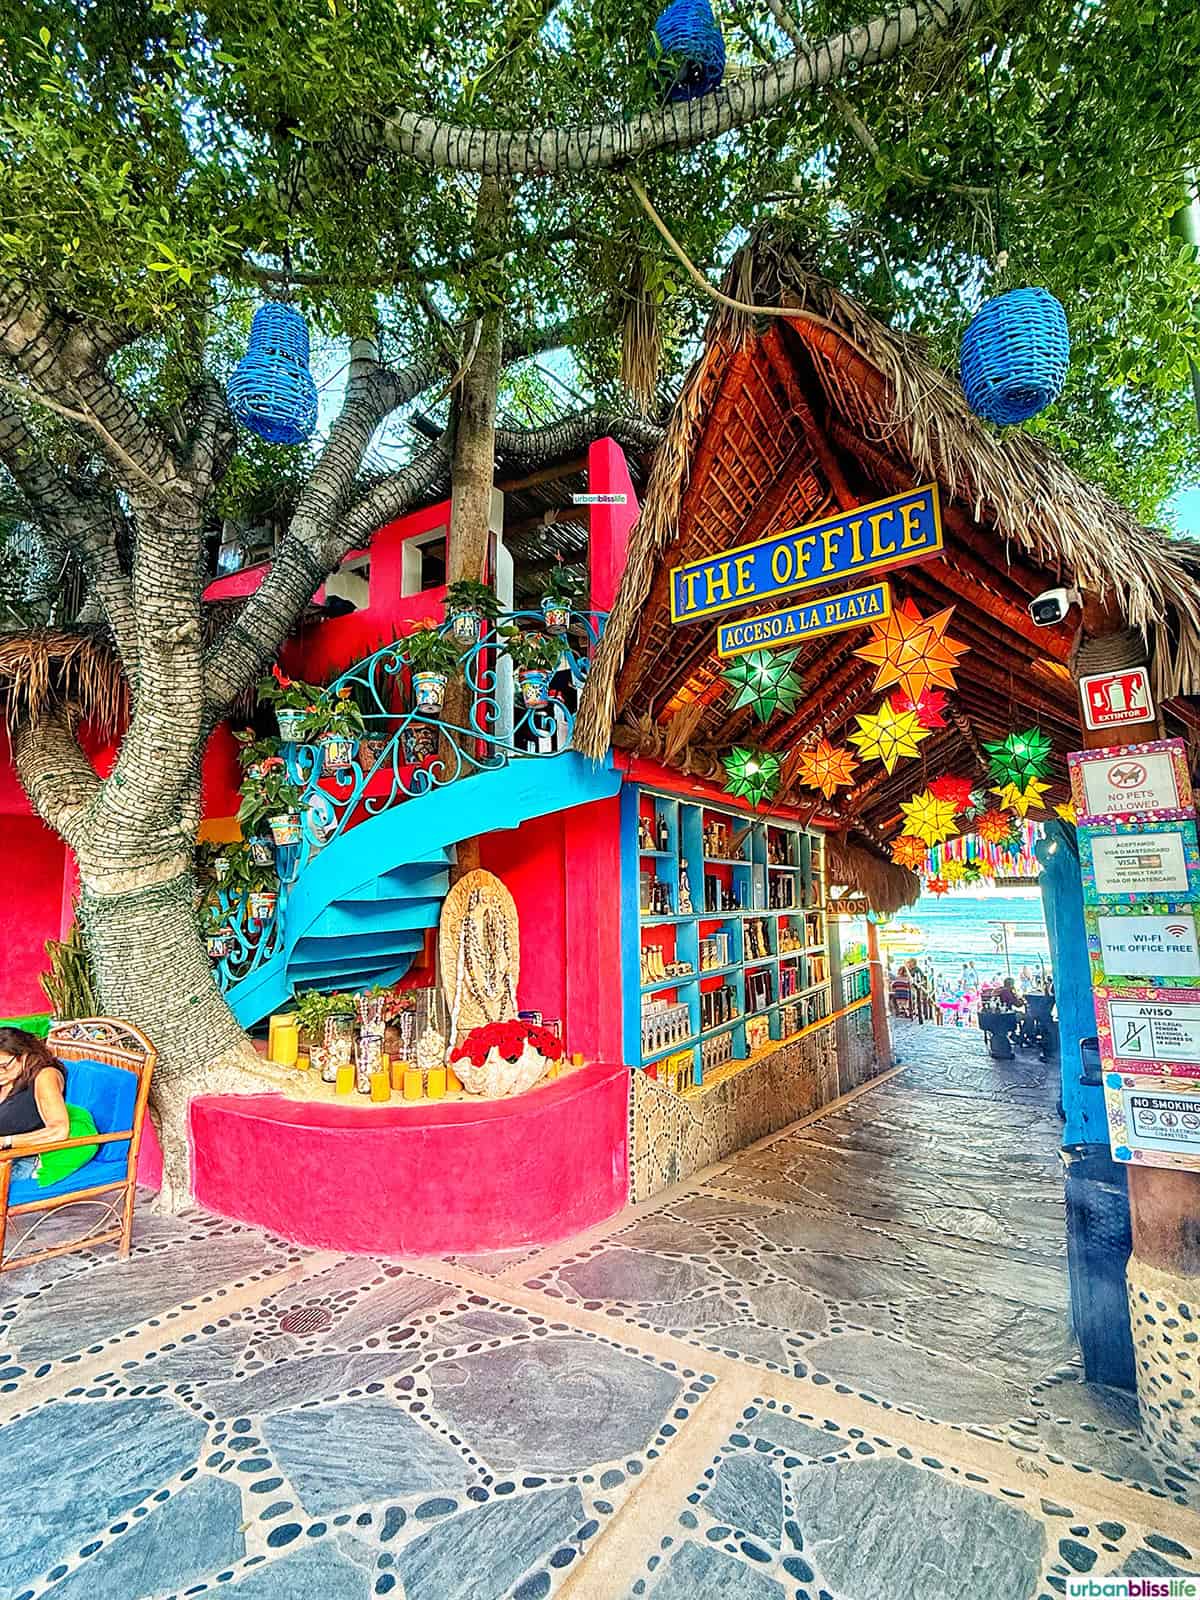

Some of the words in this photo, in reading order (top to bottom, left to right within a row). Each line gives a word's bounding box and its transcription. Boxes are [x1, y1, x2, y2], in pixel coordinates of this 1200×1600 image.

[682, 554, 756, 611] THE
[771, 499, 928, 585] OFFICE
[725, 618, 783, 649] ACCESO
[784, 615, 796, 634] A
[799, 611, 821, 631] LA
[824, 592, 881, 625] PLAYA
[1098, 709, 1141, 721] EXTINTOR
[1107, 792, 1124, 801] NO
[1126, 790, 1155, 799] PETS
[1107, 800, 1160, 812] ALLOWED
[1133, 934, 1162, 942] WI-FI
[1106, 944, 1126, 952] THE
[1128, 944, 1165, 952] OFFICE
[1166, 945, 1194, 953] FREE
[1139, 1007, 1173, 1017] AVISO
[1134, 1098, 1149, 1107] NO
[1151, 1099, 1200, 1113] SMOKING
